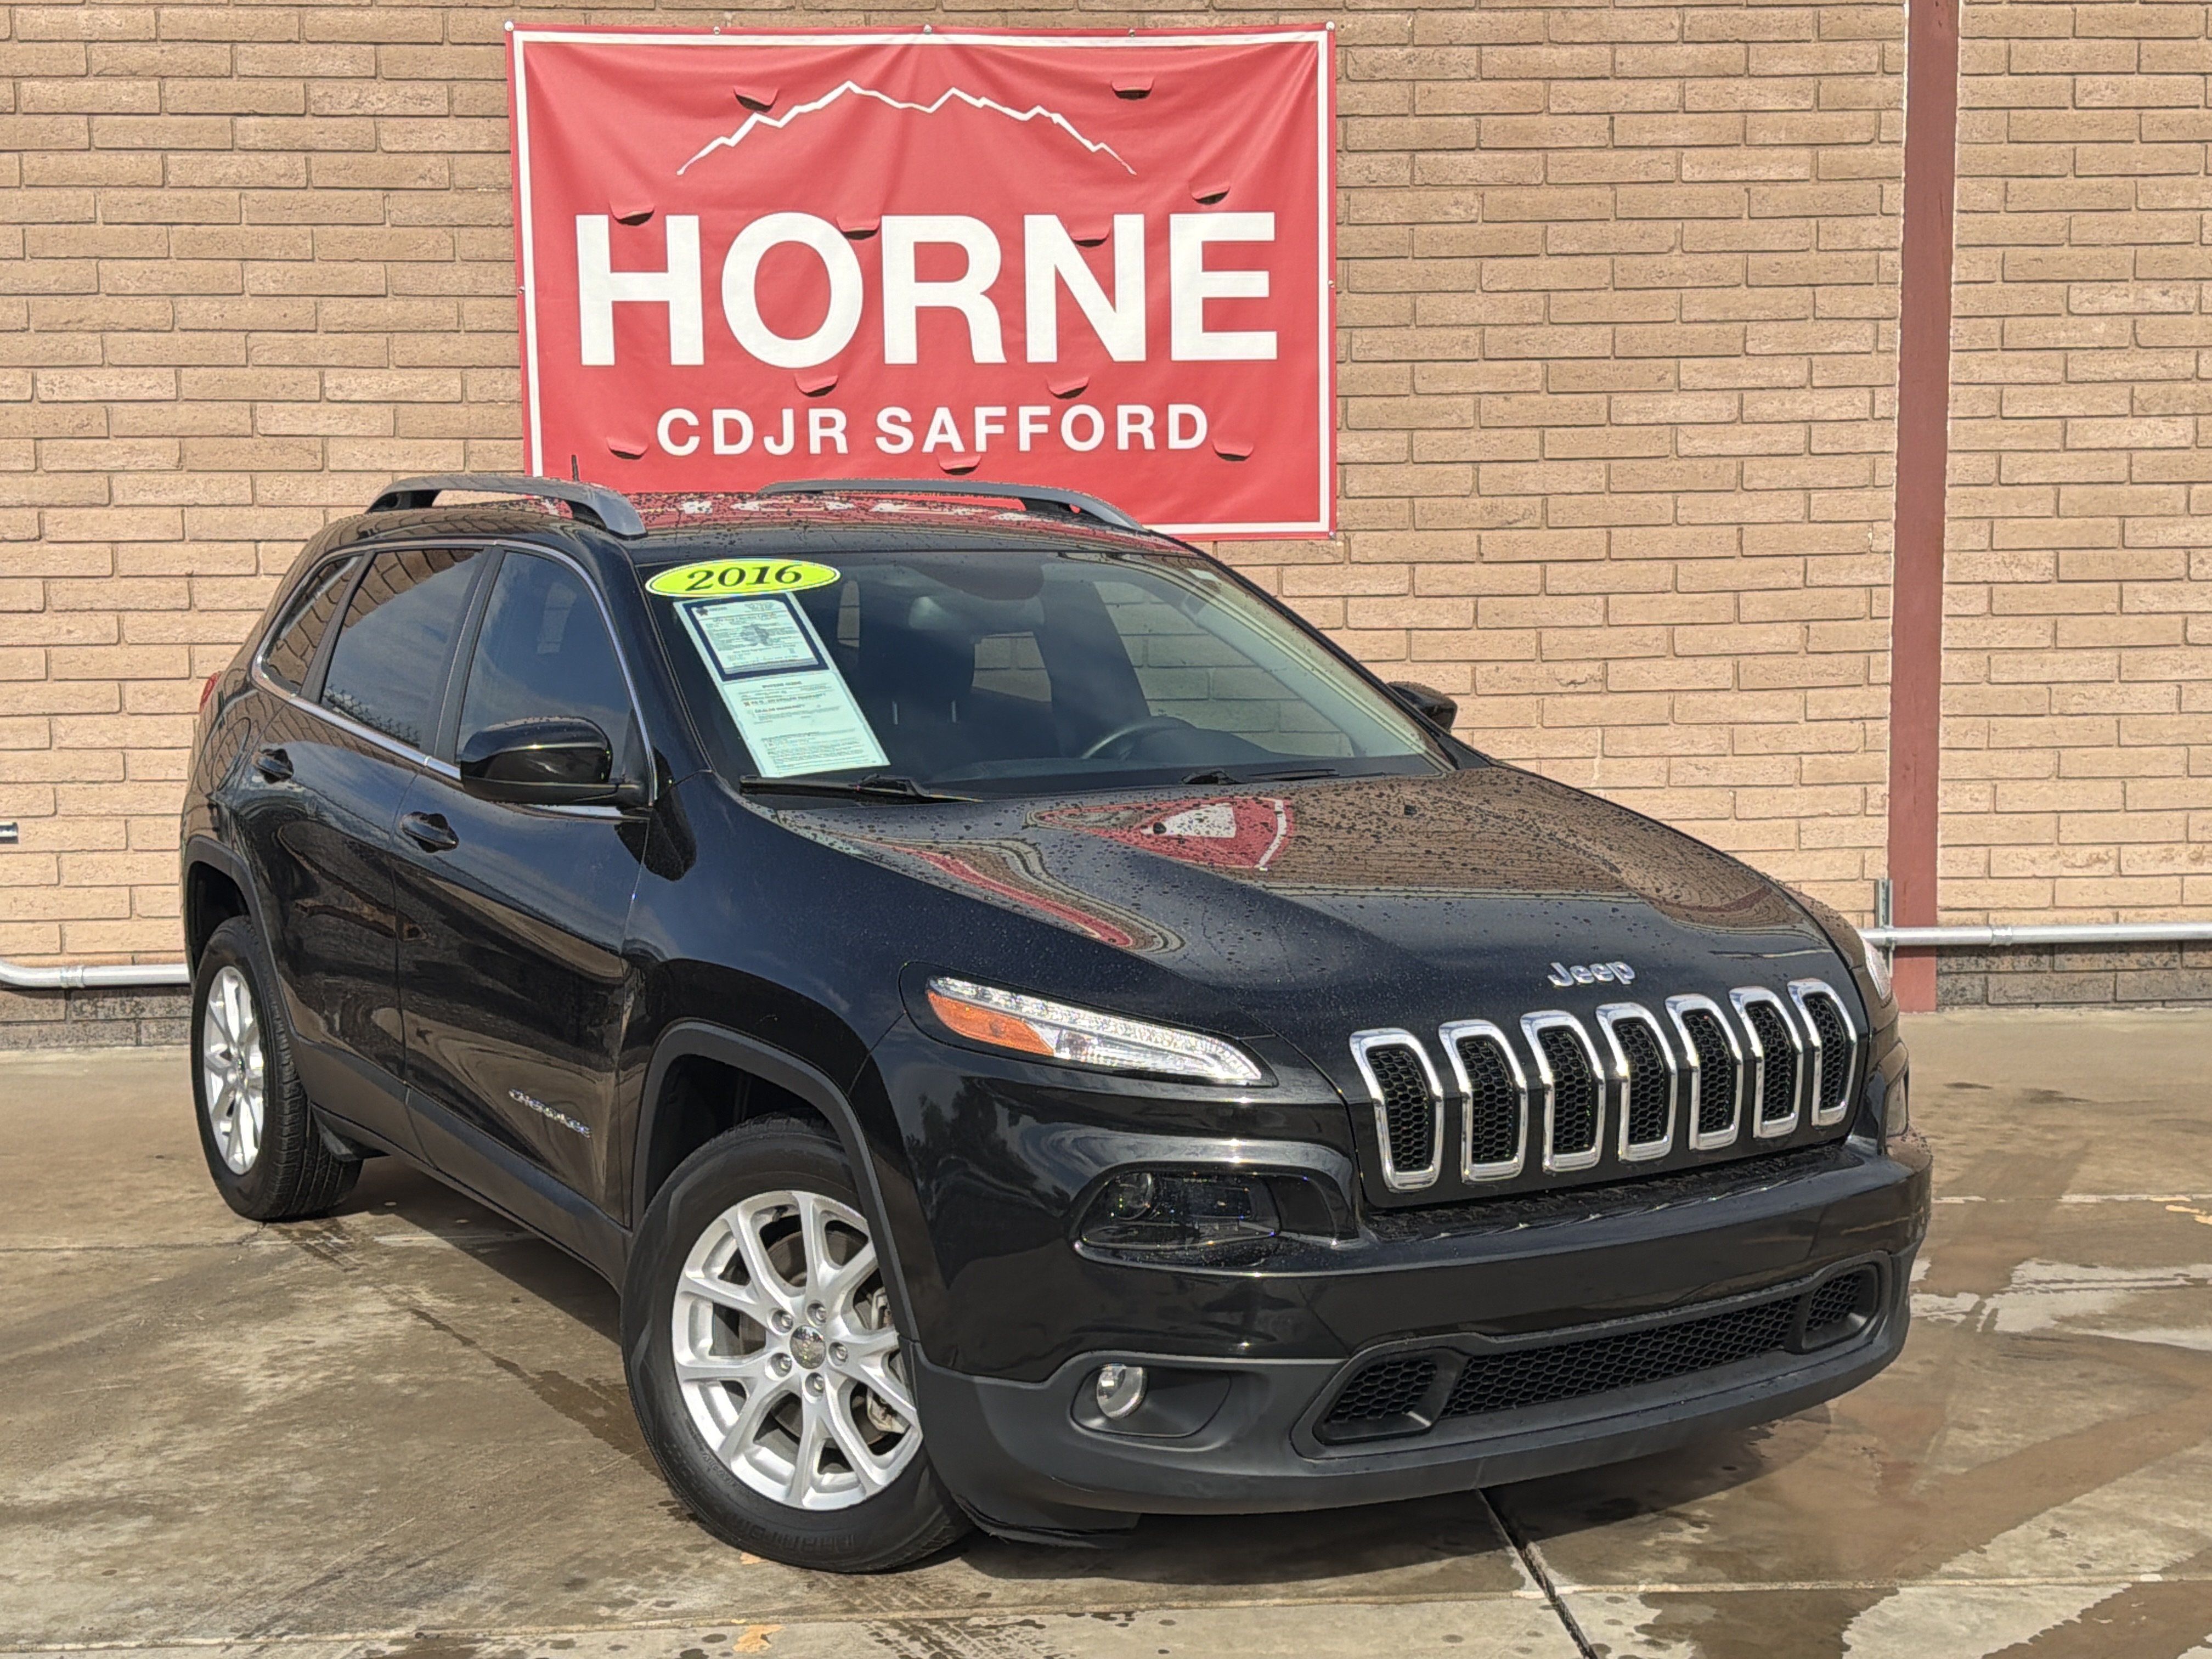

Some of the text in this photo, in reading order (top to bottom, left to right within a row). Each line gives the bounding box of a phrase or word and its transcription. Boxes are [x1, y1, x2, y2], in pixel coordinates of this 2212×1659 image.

[575, 212, 1278, 369] HORNE
[657, 404, 1207, 456] CDJR SAFFORD
[685, 565, 802, 591] 2016
[1547, 961, 1635, 987] Jeep
